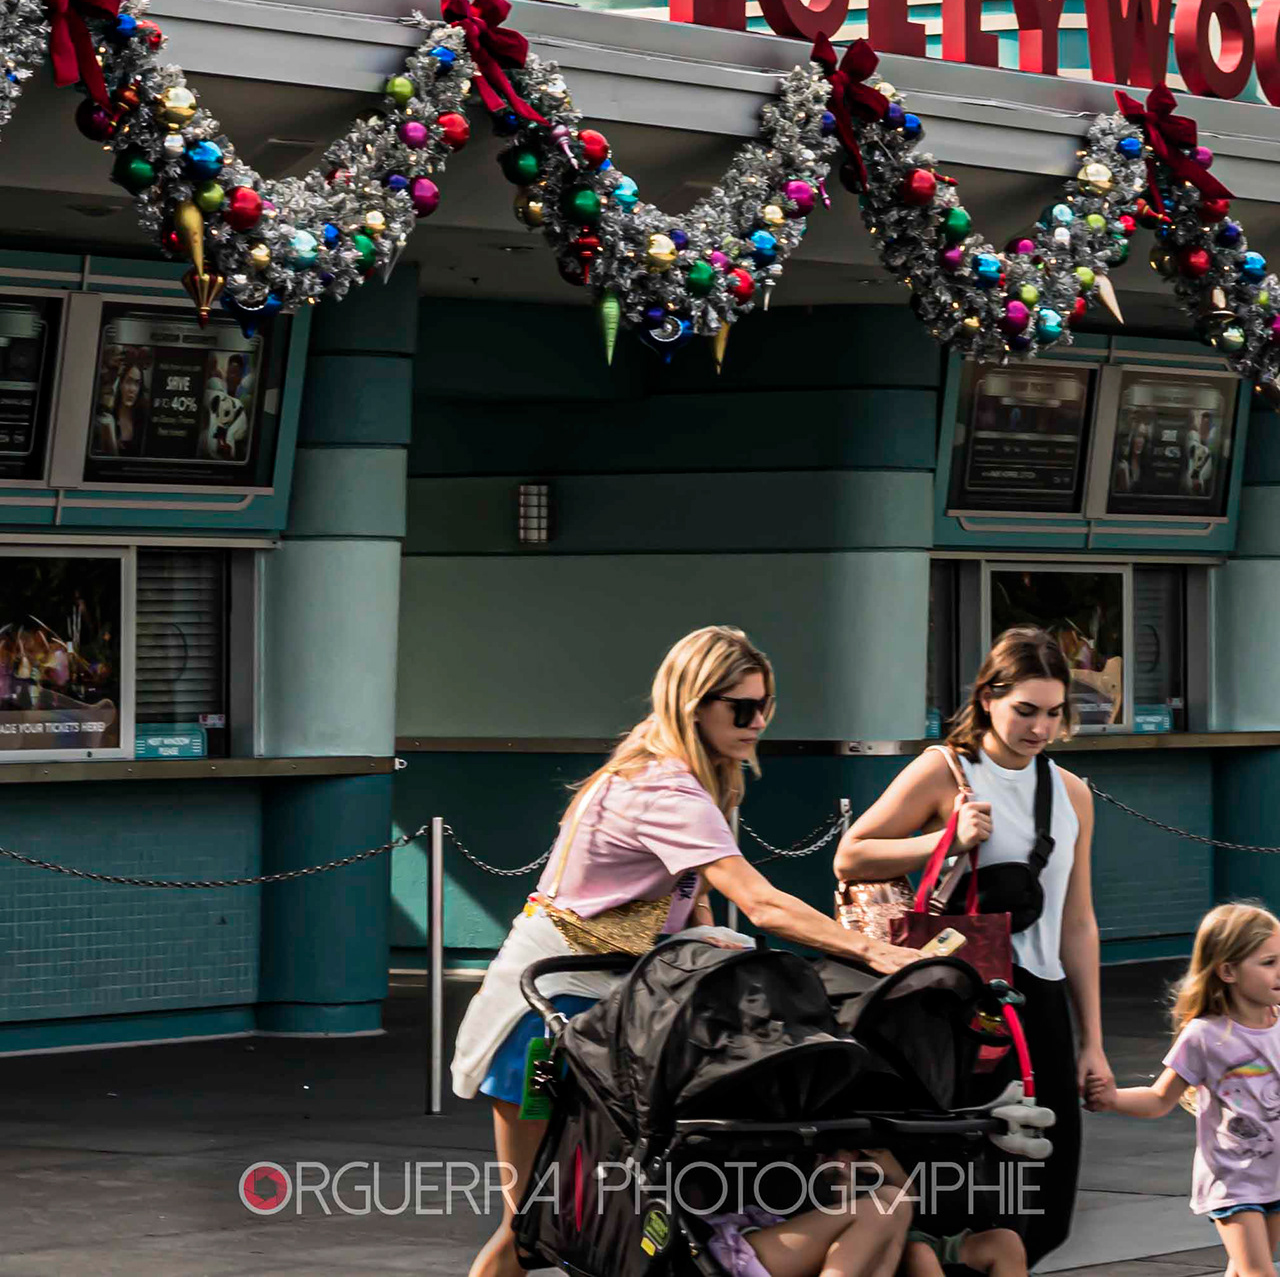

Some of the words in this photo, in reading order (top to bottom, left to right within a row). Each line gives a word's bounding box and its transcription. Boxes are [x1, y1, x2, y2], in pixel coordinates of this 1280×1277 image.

[171, 395, 198, 413] 40%
[18, 722, 44, 734] YOUR
[45, 721, 80, 733] TICKETS
